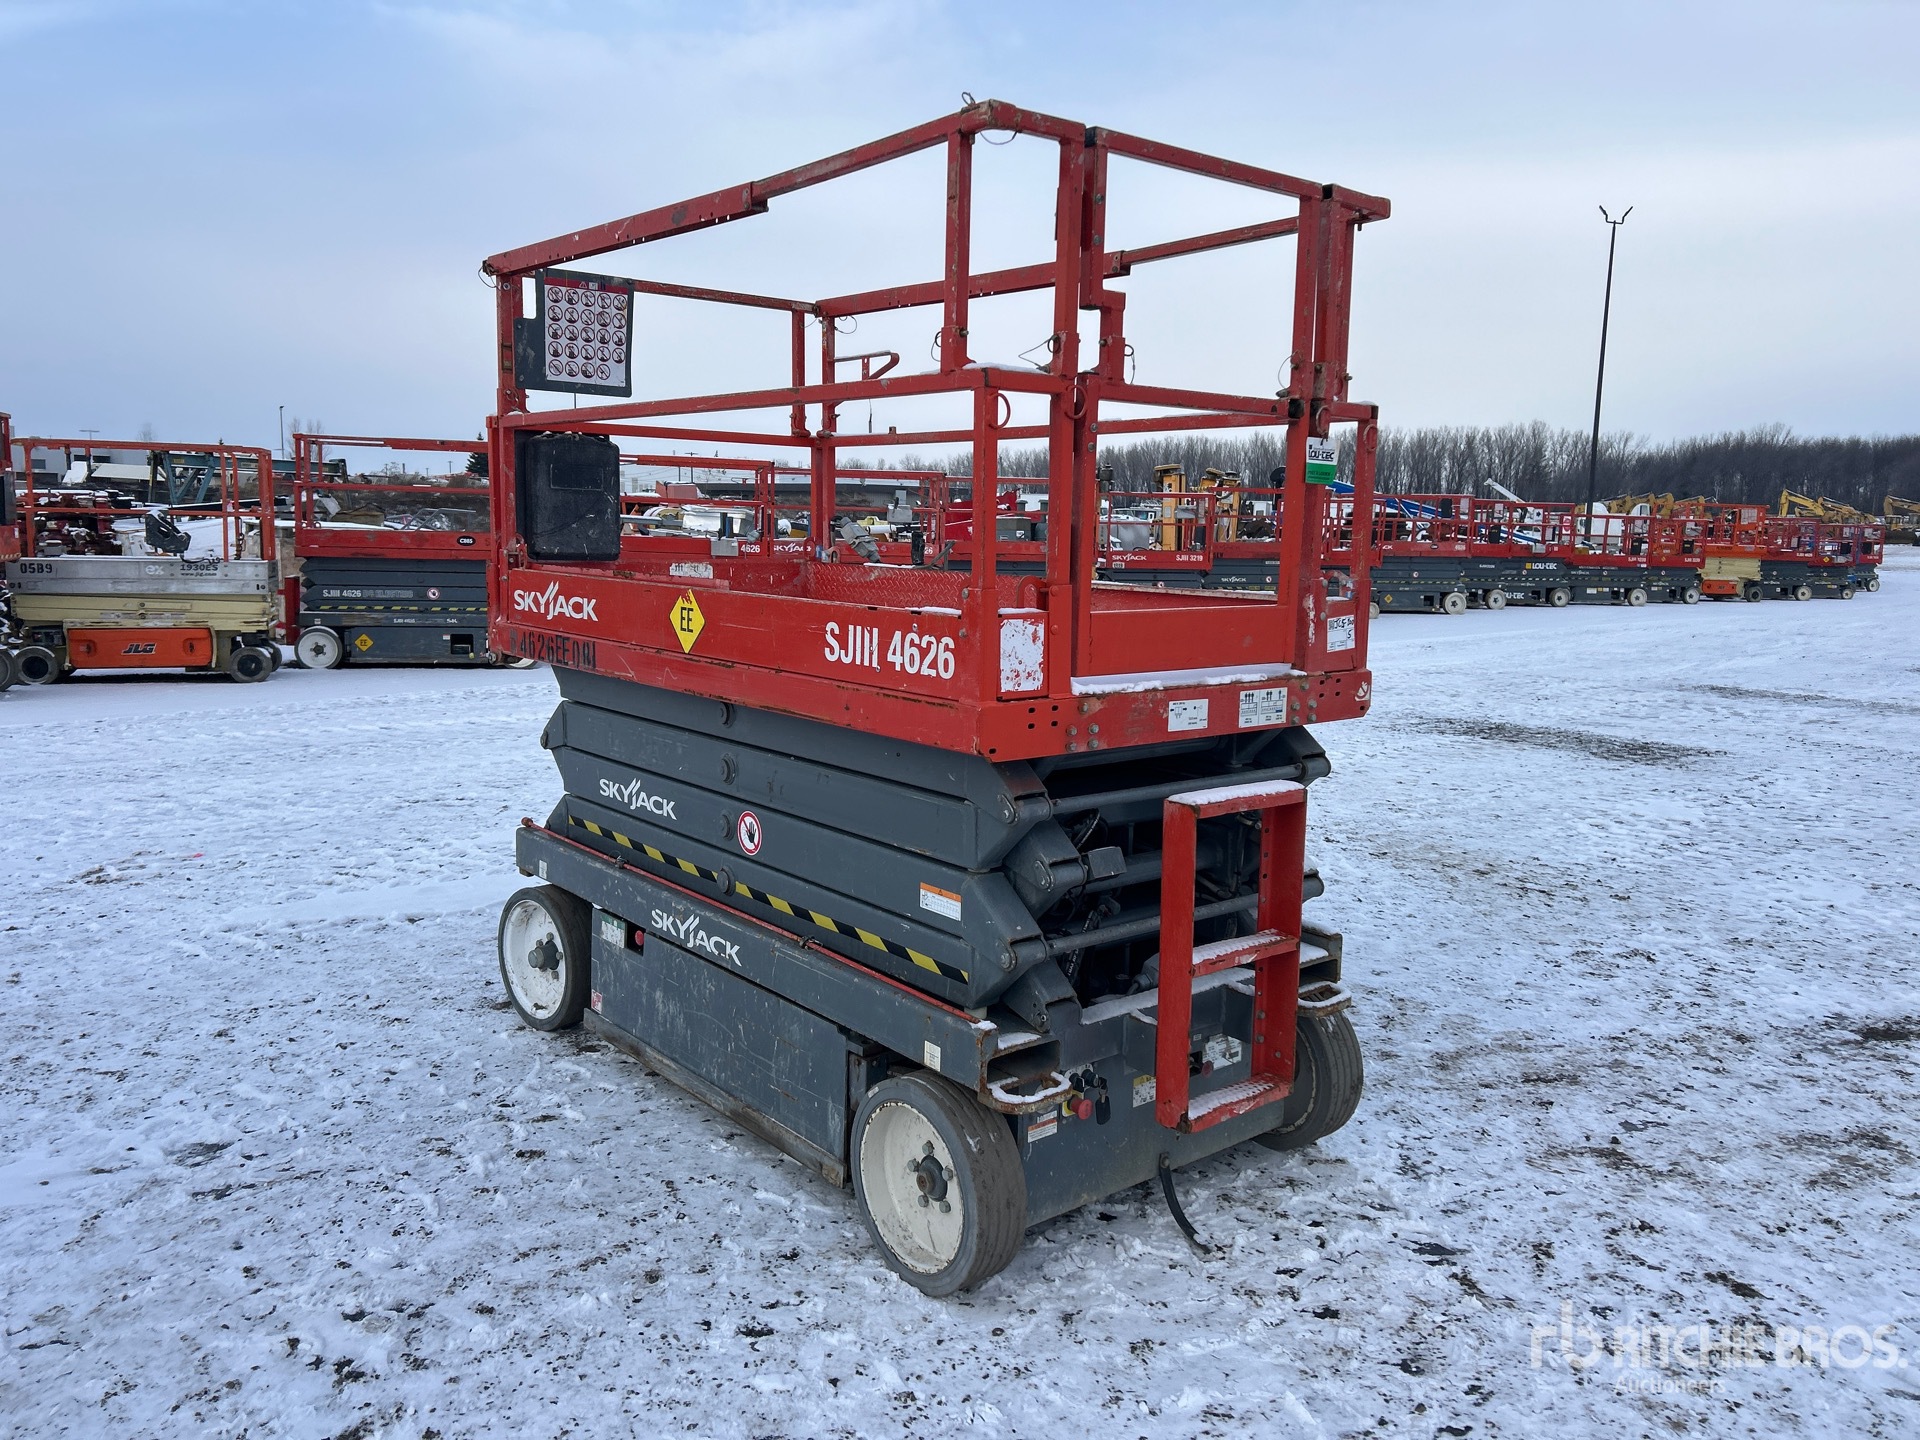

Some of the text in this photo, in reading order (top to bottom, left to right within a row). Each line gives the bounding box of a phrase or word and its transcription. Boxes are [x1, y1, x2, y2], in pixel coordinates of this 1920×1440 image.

[740, 544, 761, 553] 4626
[1111, 553, 1147, 561] SKYJACK
[513, 580, 599, 622] SKYJACK
[680, 606, 694, 633] EE
[122, 642, 157, 655] JLG
[887, 630, 955, 680] 4626
[599, 777, 678, 821] SKYJACK
[651, 908, 742, 967] SKYJACK
